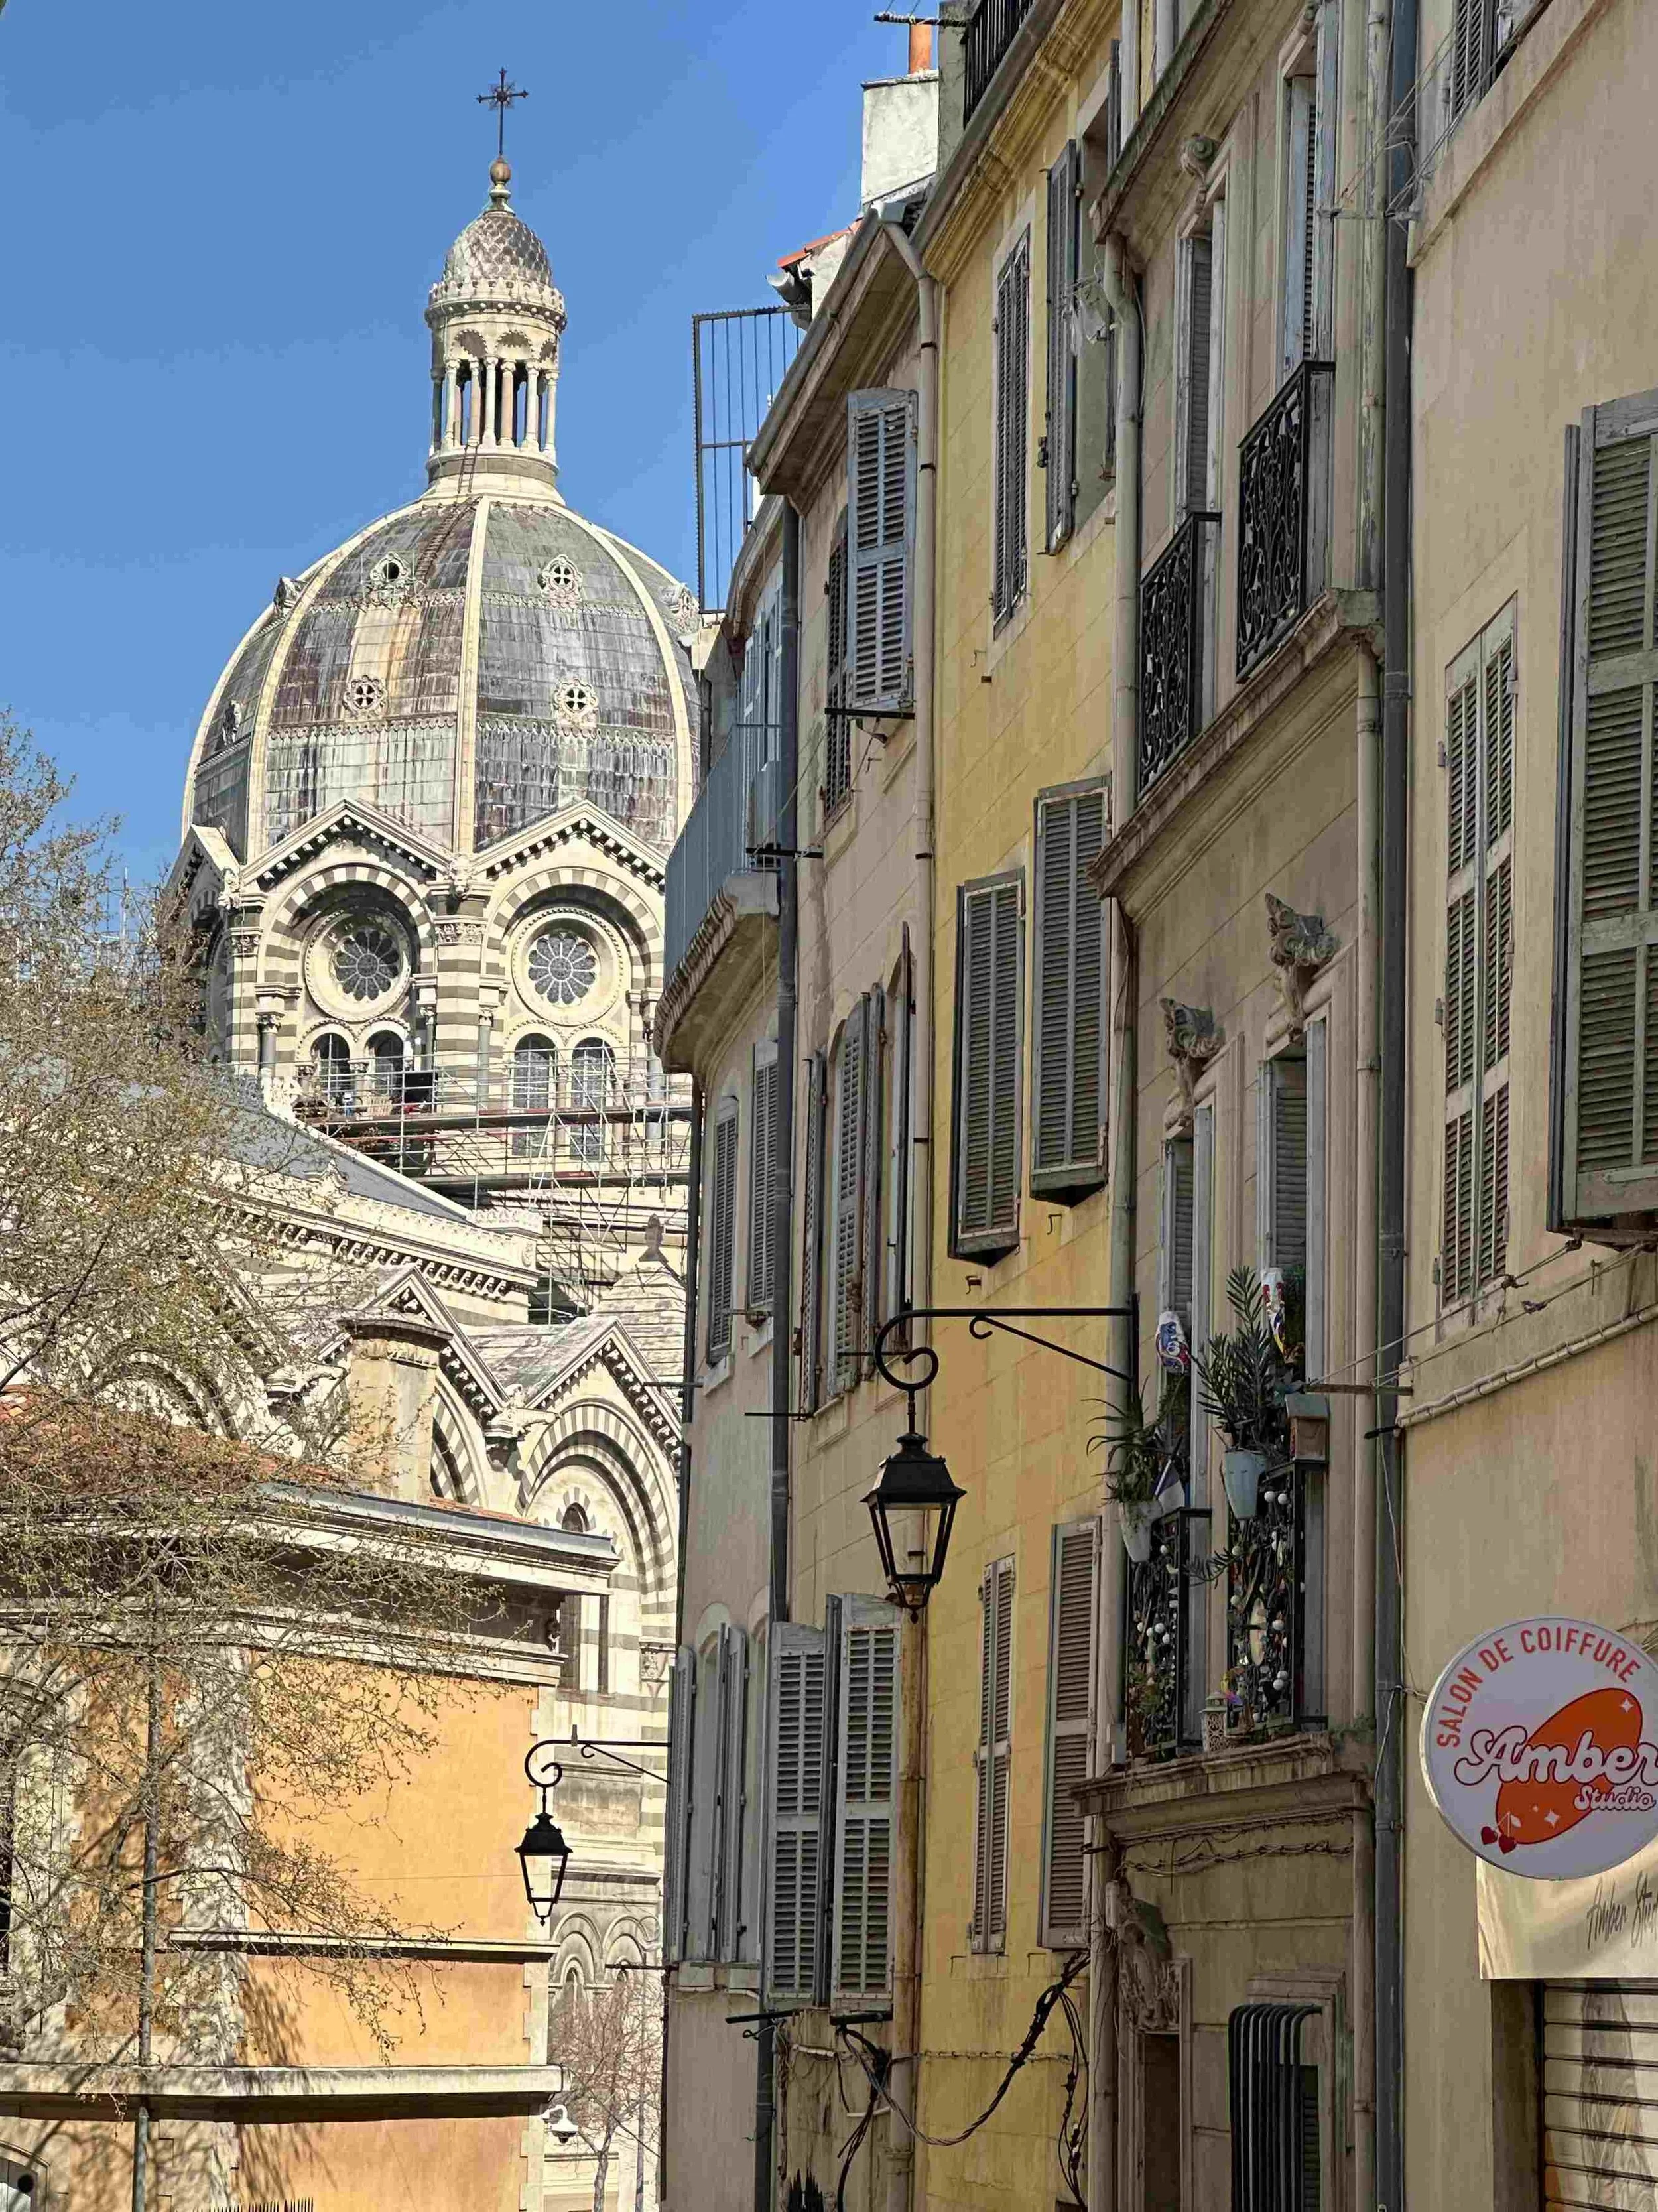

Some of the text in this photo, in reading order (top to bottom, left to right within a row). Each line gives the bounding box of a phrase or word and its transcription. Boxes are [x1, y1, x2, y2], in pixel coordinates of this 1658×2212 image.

[1437, 1626, 1641, 1748] SALON DE COIFFURE
[1574, 1784, 1657, 1811] Studio
